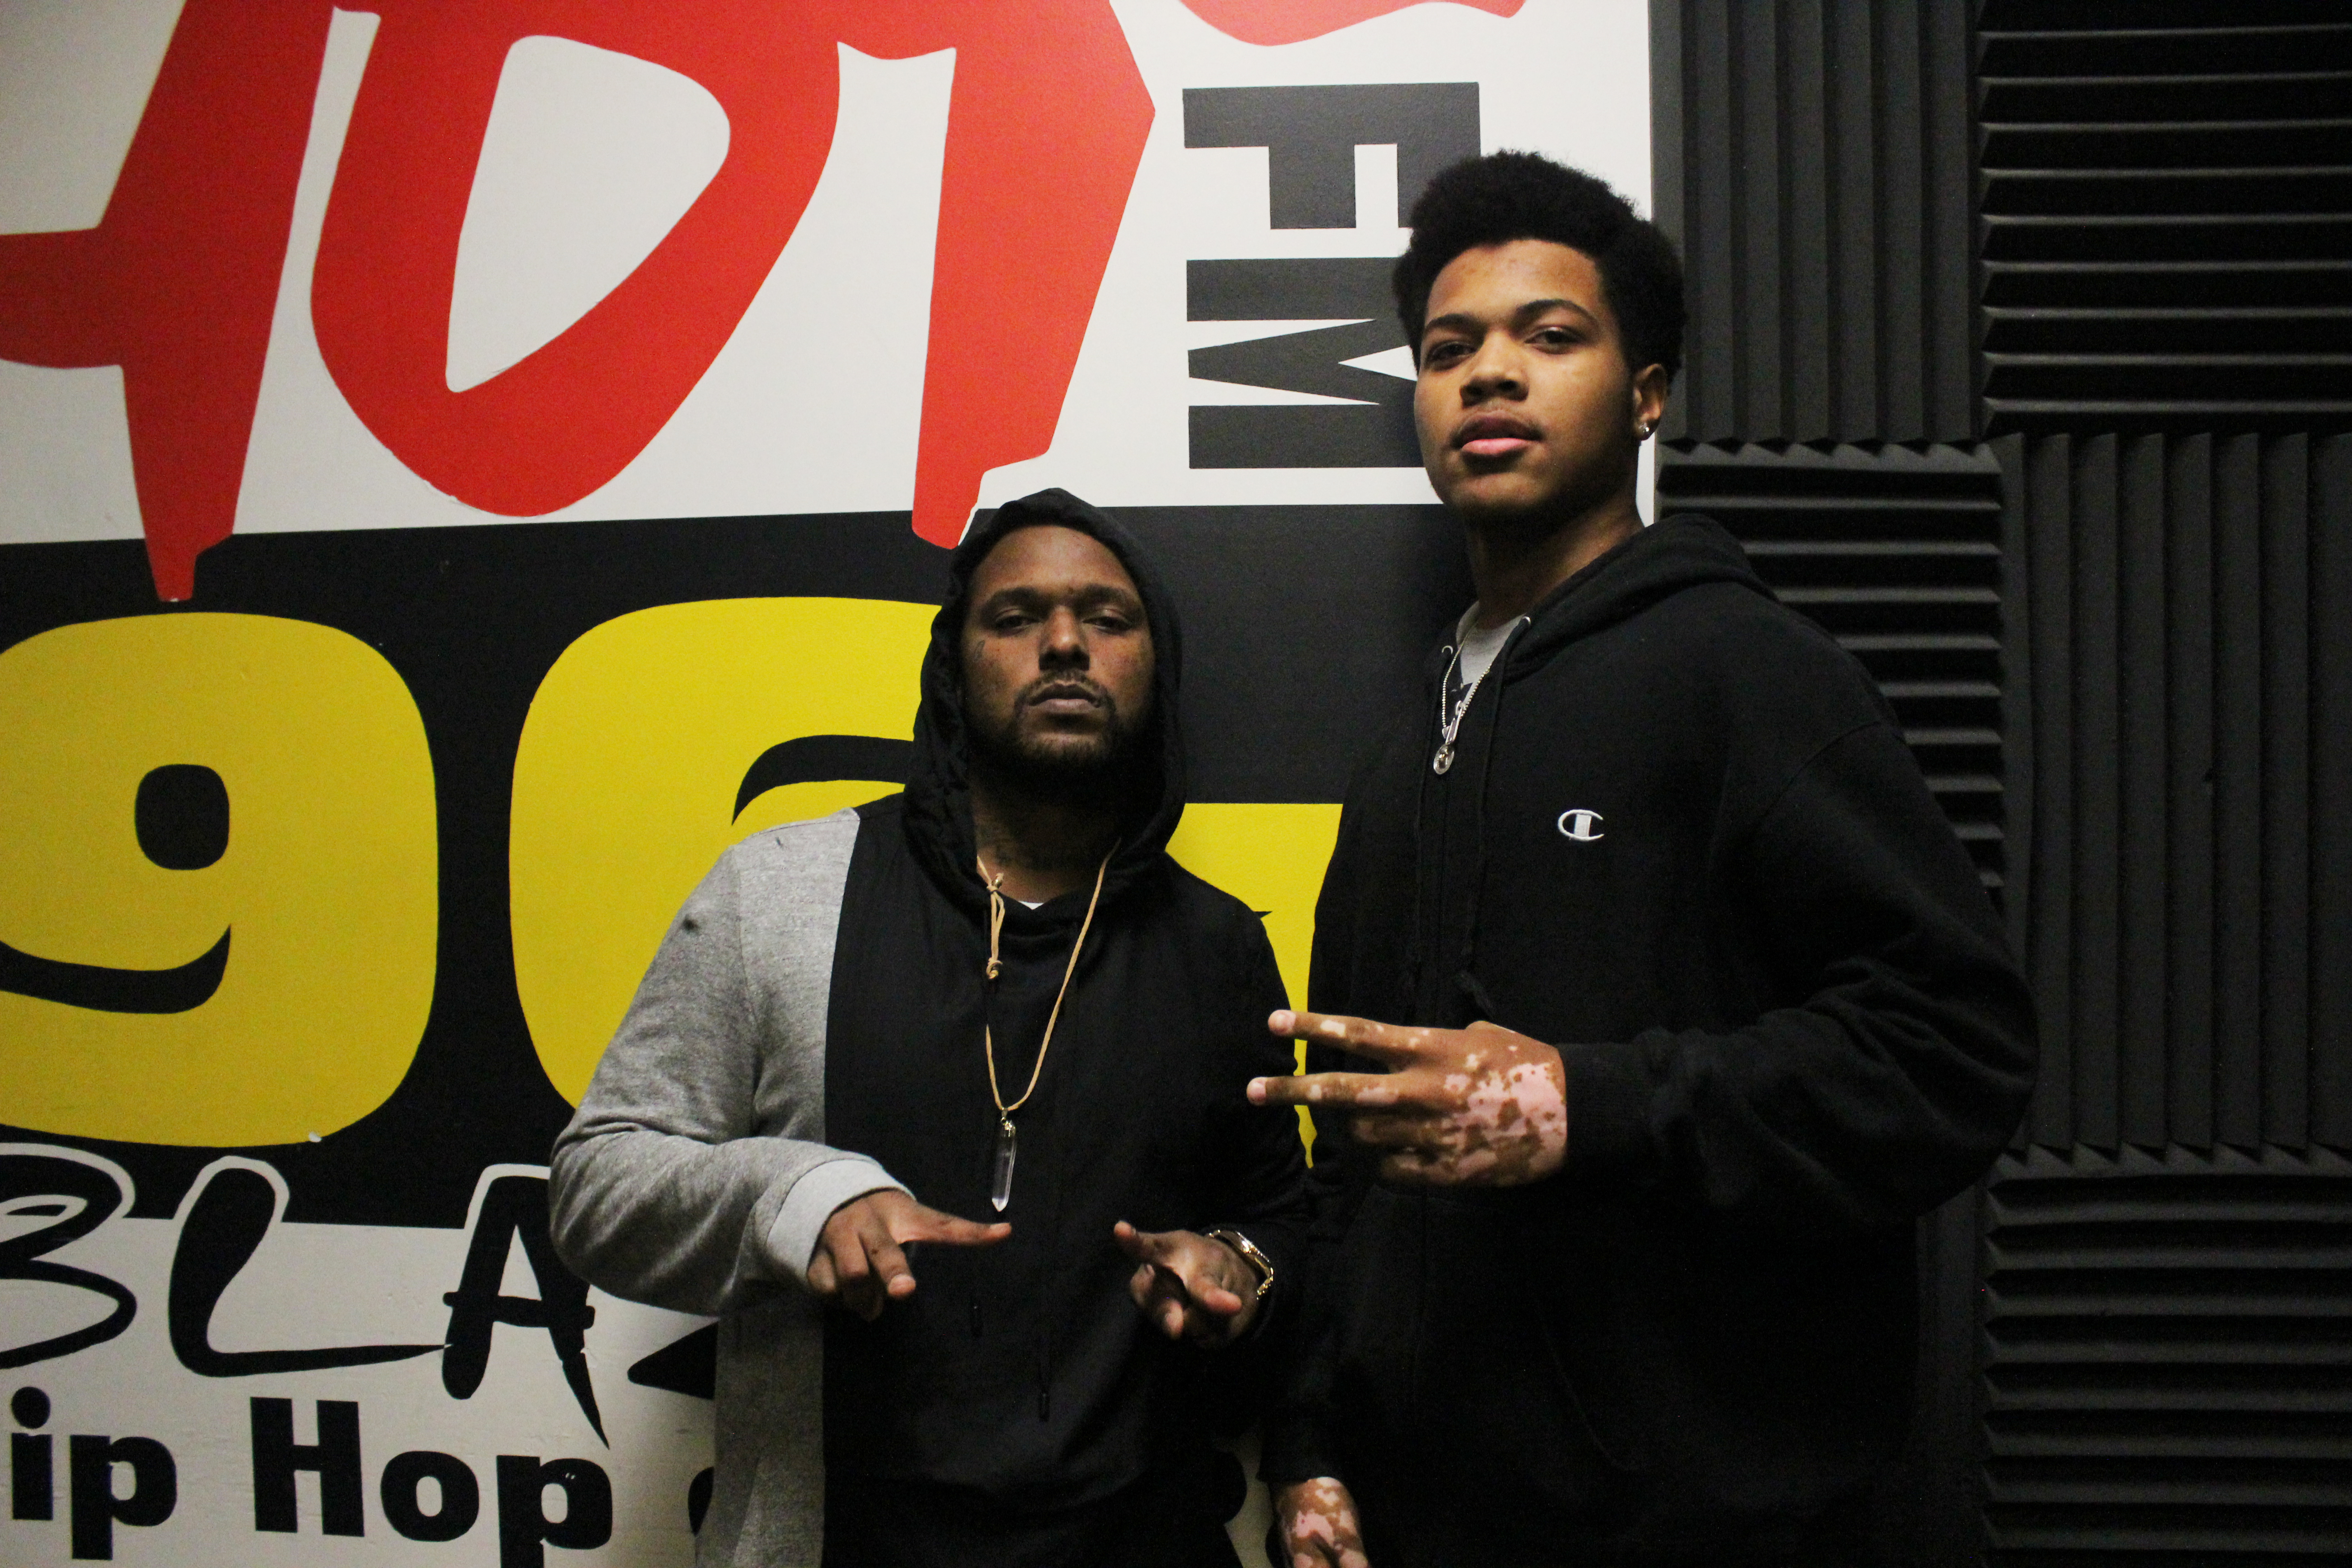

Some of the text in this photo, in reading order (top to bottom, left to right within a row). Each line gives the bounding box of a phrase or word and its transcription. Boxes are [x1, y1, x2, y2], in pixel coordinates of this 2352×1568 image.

[1182, 82, 1480, 469] FM
[0, 1142, 718, 1449] BLA
[11, 1387, 177, 1561] ip
[250, 1396, 612, 1568] Hop
